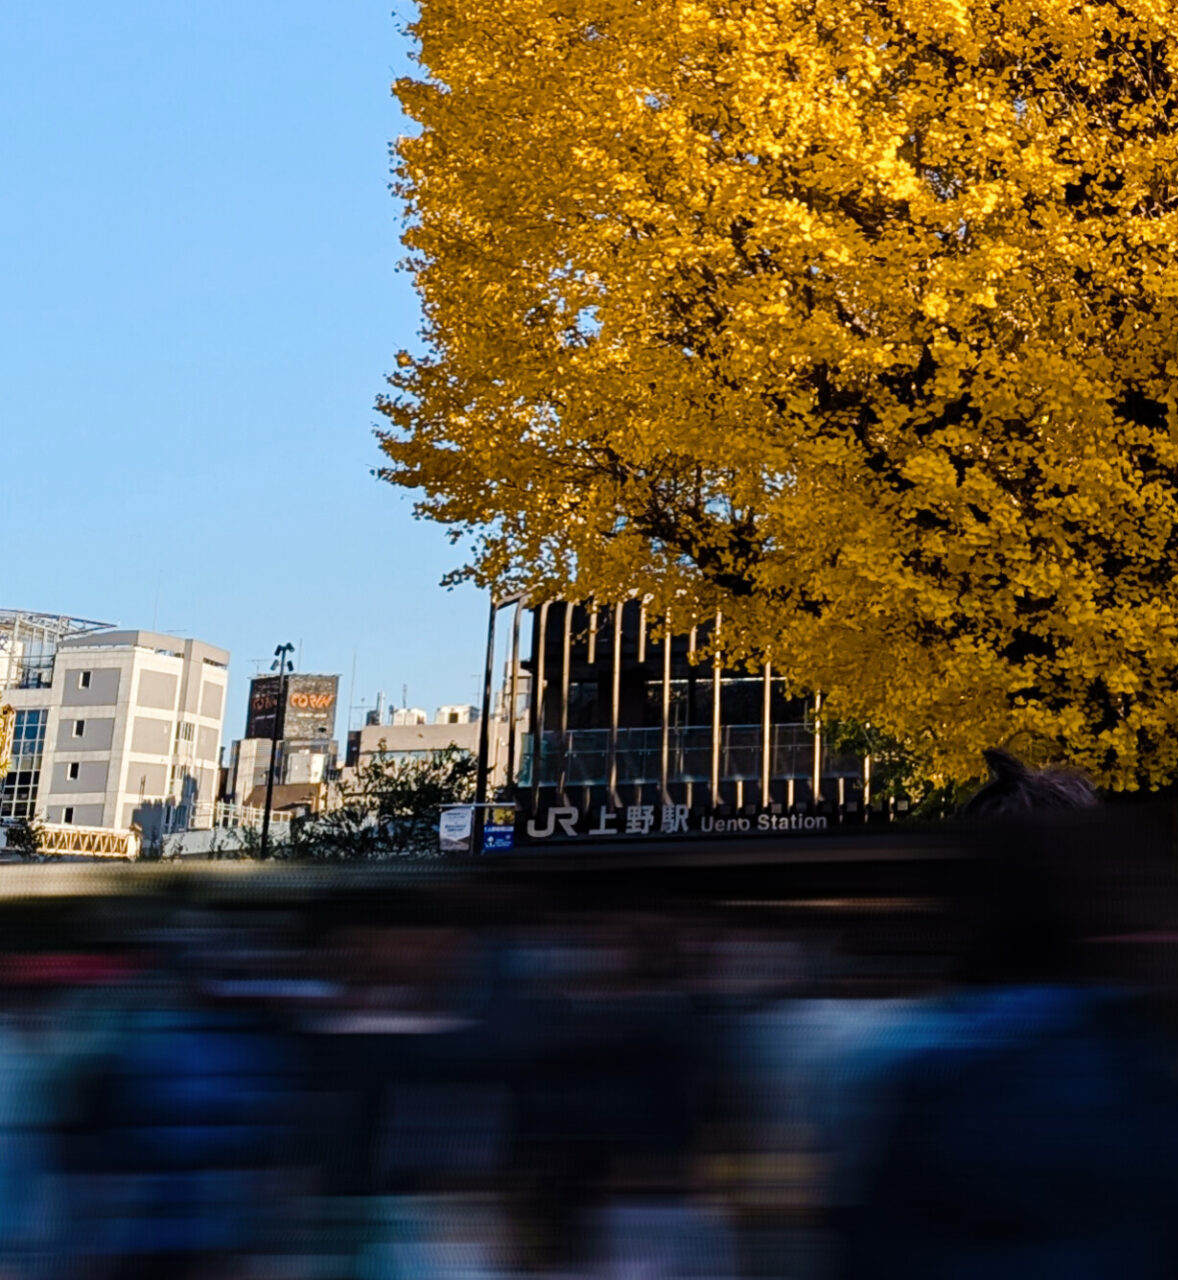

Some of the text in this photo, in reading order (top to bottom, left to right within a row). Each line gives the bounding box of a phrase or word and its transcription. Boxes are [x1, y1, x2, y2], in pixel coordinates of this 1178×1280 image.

[527, 804, 827, 838] JR 上野駅 Ueno Station
